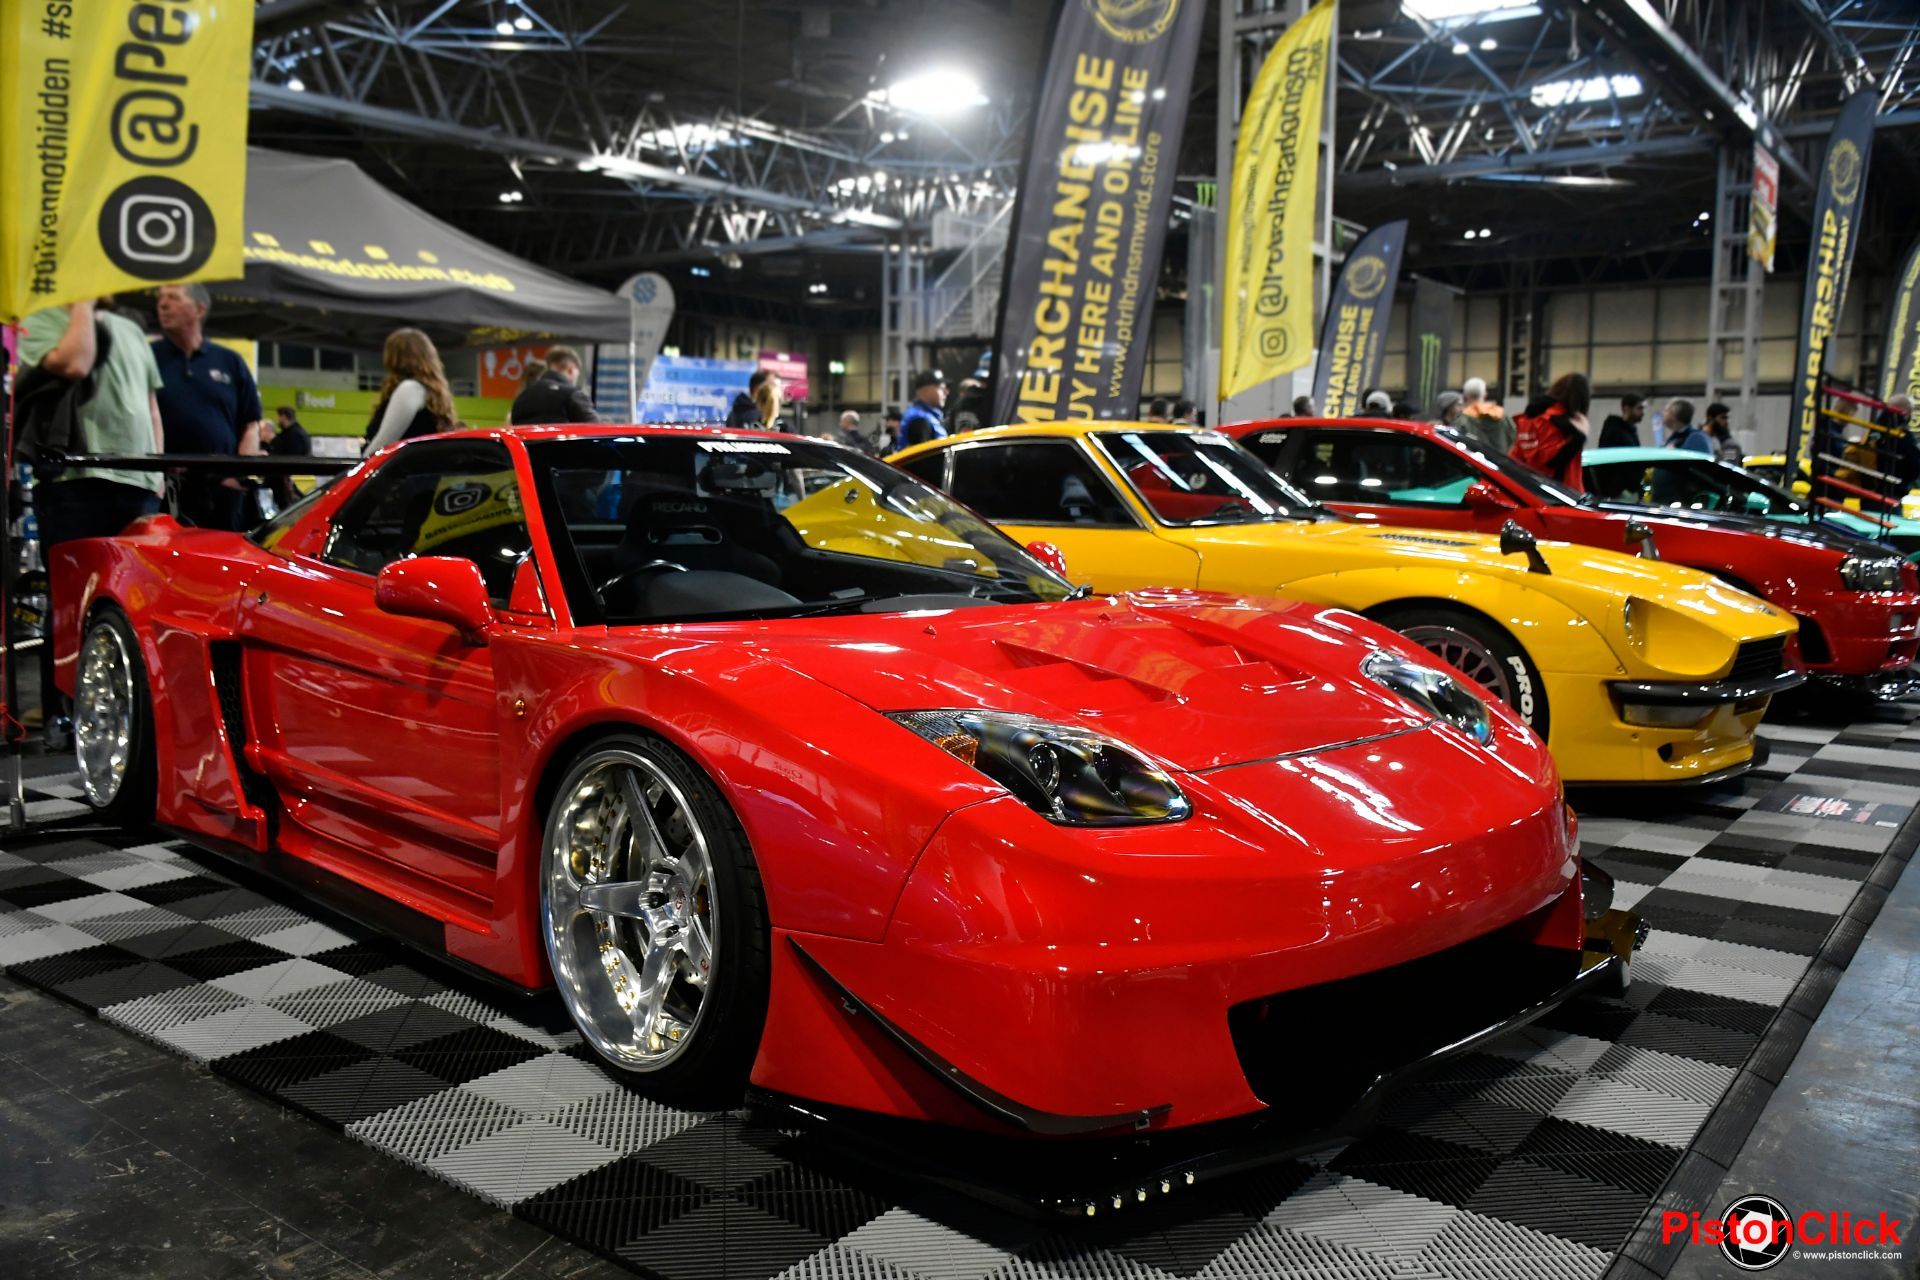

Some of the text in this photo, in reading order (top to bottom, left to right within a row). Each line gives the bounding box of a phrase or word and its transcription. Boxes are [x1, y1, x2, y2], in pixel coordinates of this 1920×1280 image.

[110, 0, 200, 168] @Pe
[1067, 66, 1149, 421] UY HERE AND ONLINE
[1108, 130, 1162, 399] www.ptrlhdnsmwrld.store
[1323, 305, 1359, 418] CHANDISE
